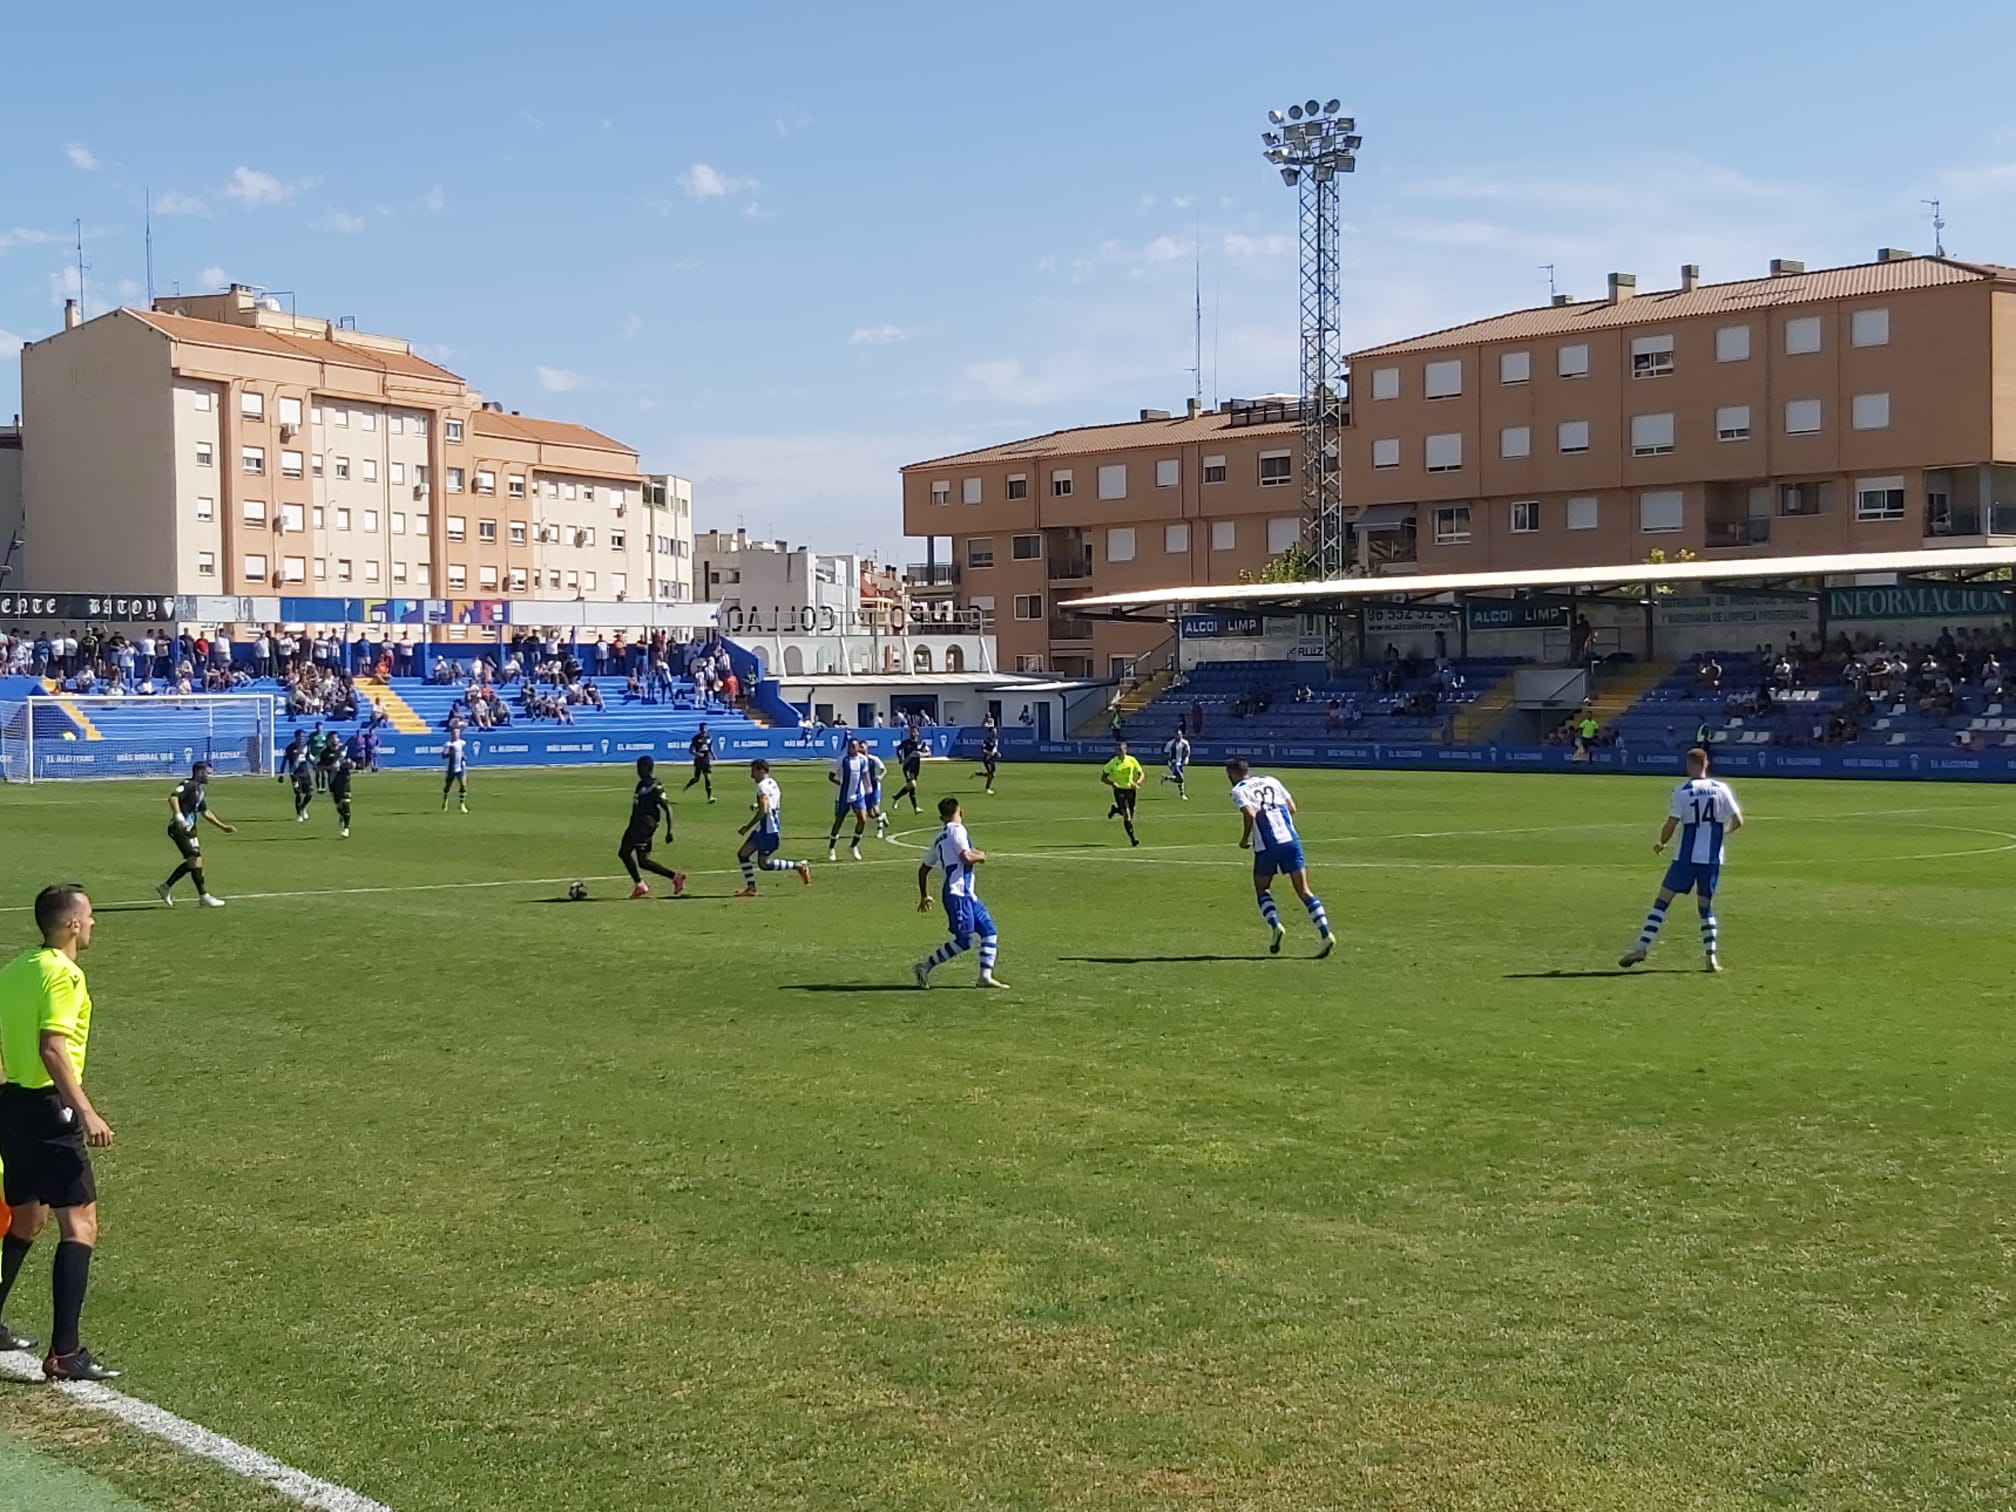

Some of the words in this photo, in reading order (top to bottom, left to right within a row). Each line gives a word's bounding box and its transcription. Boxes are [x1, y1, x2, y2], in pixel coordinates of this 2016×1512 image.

[1475, 610, 1512, 623] ALCOI
[1525, 608, 1559, 621] LIMP
[1185, 621, 1218, 633] ALCOI
[1228, 619, 1257, 631] LIMP
[1298, 647, 1324, 656] RUIZ
[1254, 786, 1277, 811] 22
[1689, 797, 1716, 828] 14
